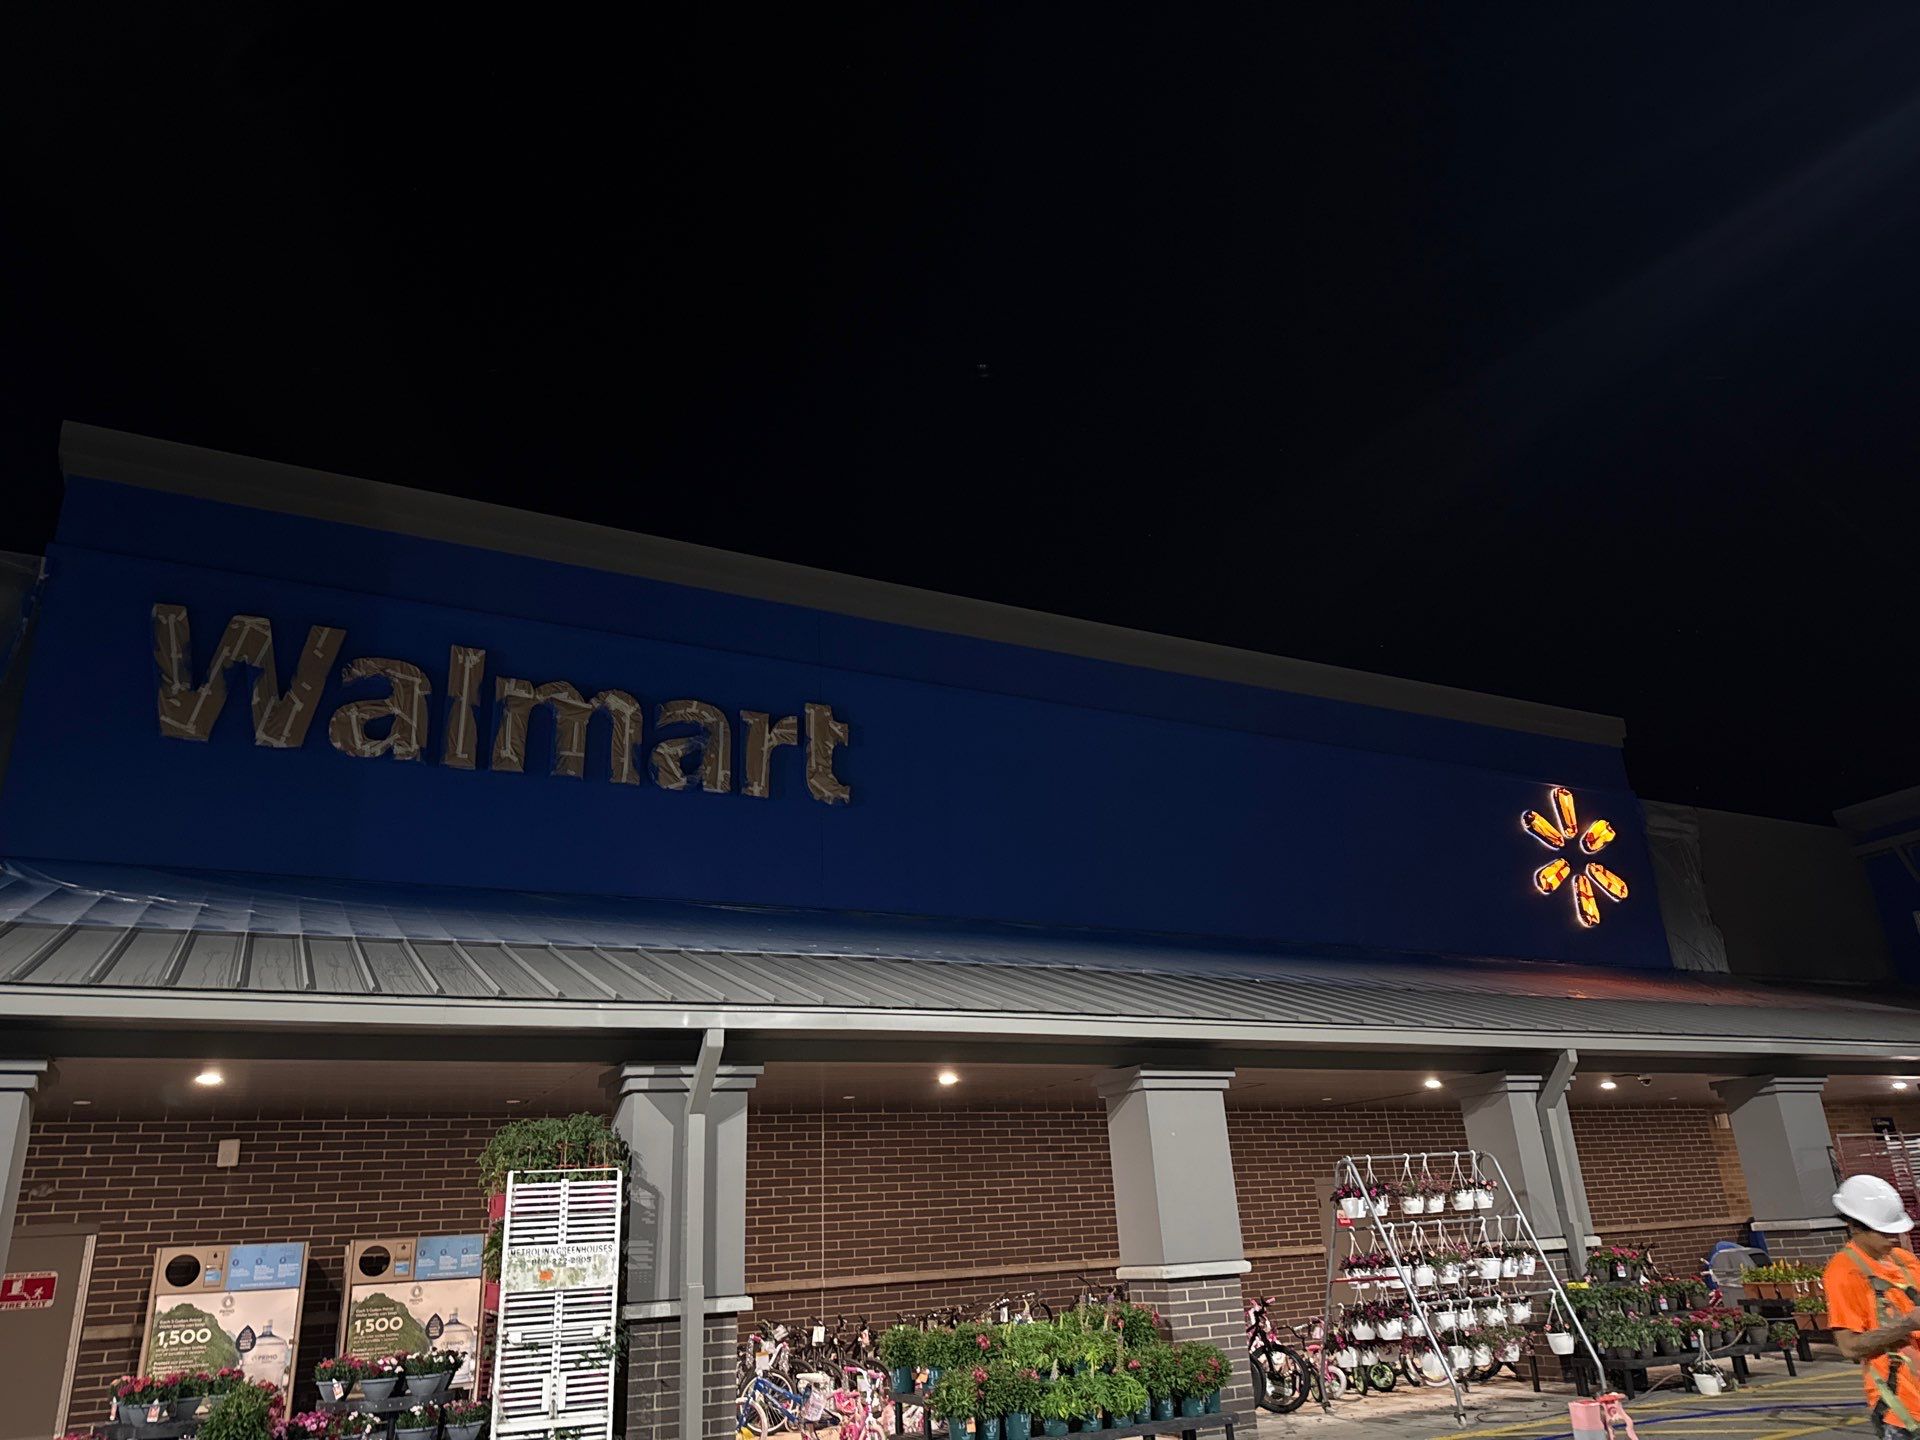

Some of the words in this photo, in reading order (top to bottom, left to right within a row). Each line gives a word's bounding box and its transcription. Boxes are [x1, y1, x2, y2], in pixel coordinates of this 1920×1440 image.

[152, 603, 850, 804] Walmart
[24, 1300, 47, 1308] EXIT
[354, 1316, 404, 1336] 1,500
[157, 1328, 212, 1349] 1,500
